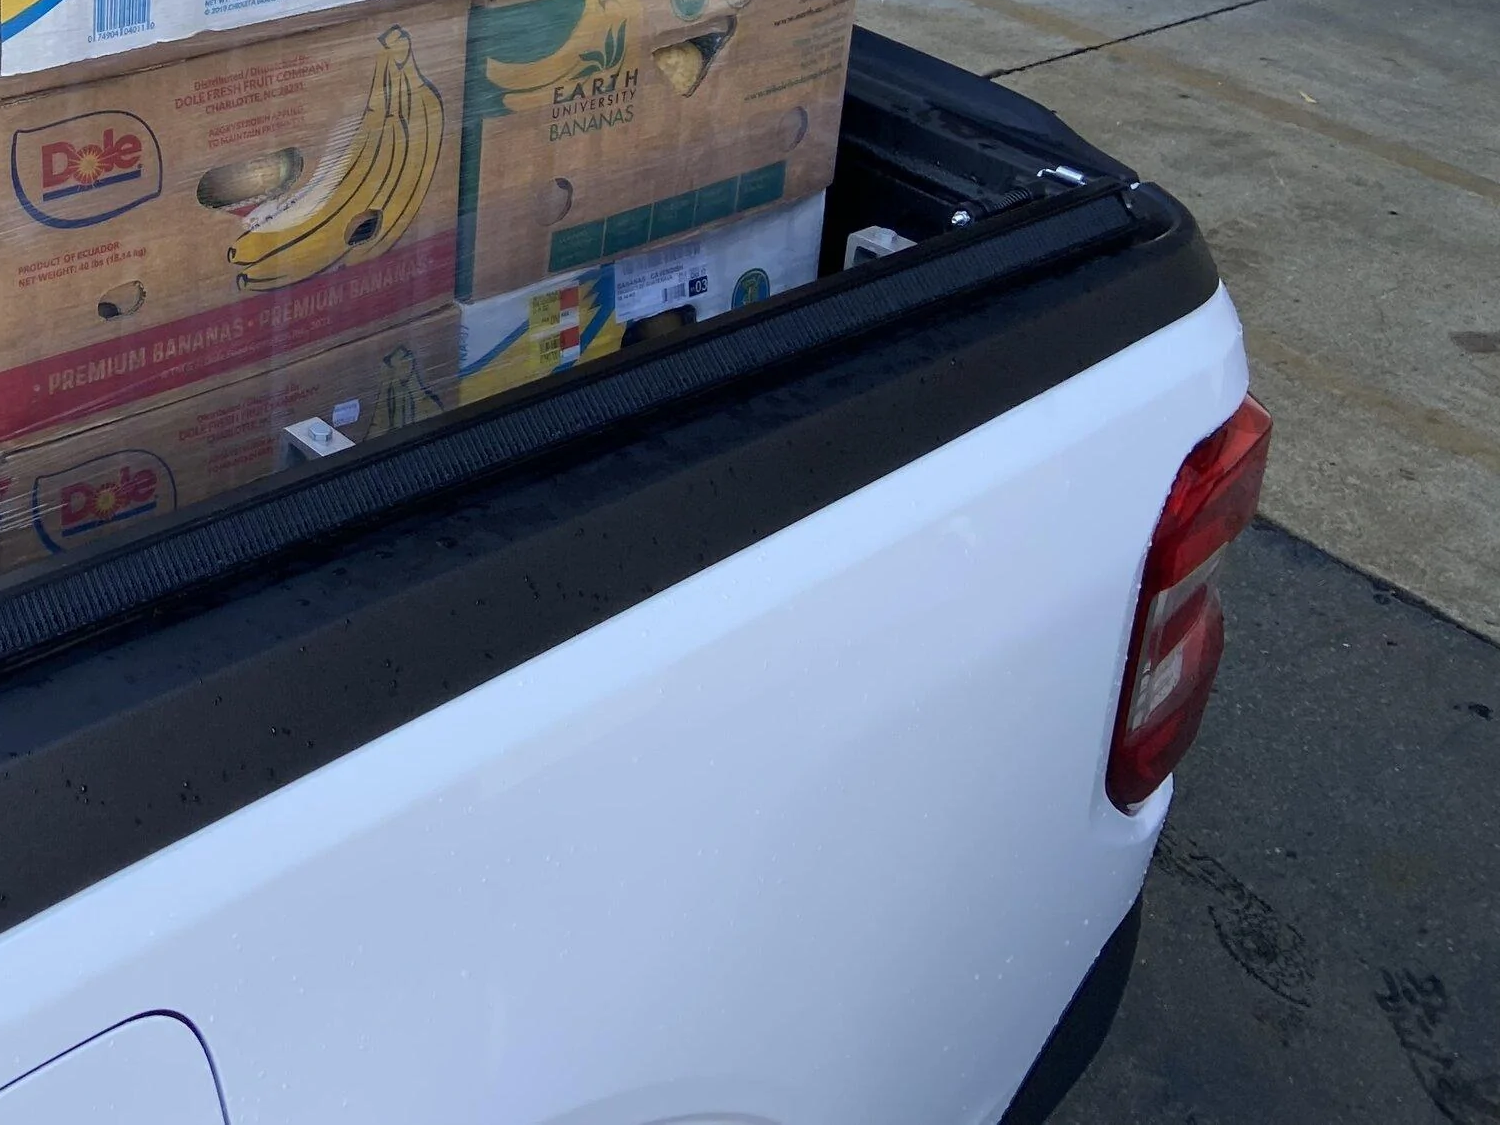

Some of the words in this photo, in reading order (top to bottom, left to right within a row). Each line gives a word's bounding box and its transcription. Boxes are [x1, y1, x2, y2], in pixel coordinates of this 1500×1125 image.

[175, 91, 206, 109] DOLE
[207, 83, 242, 101] FRESH
[243, 75, 274, 91] FRUIT
[276, 60, 331, 82] COMPANY
[264, 90, 276, 101] NC
[553, 68, 638, 105] EARTH
[552, 88, 637, 119] UNIVERSITY
[221, 126, 262, 146] MAINTAIN
[550, 104, 634, 142] BANANAS
[42, 128, 142, 189] Dole
[18, 257, 61, 275] PRODUCT
[63, 252, 76, 263] OF
[77, 241, 121, 258] ECUADOR
[18, 276, 36, 288] NET
[695, 277, 708, 293] 03
[48, 347, 146, 395] PREMIUM
[152, 319, 244, 363] BANANAS
[259, 283, 344, 327] PREMIUM
[351, 258, 430, 297] BANANAS
[61, 466, 158, 526] Dole
